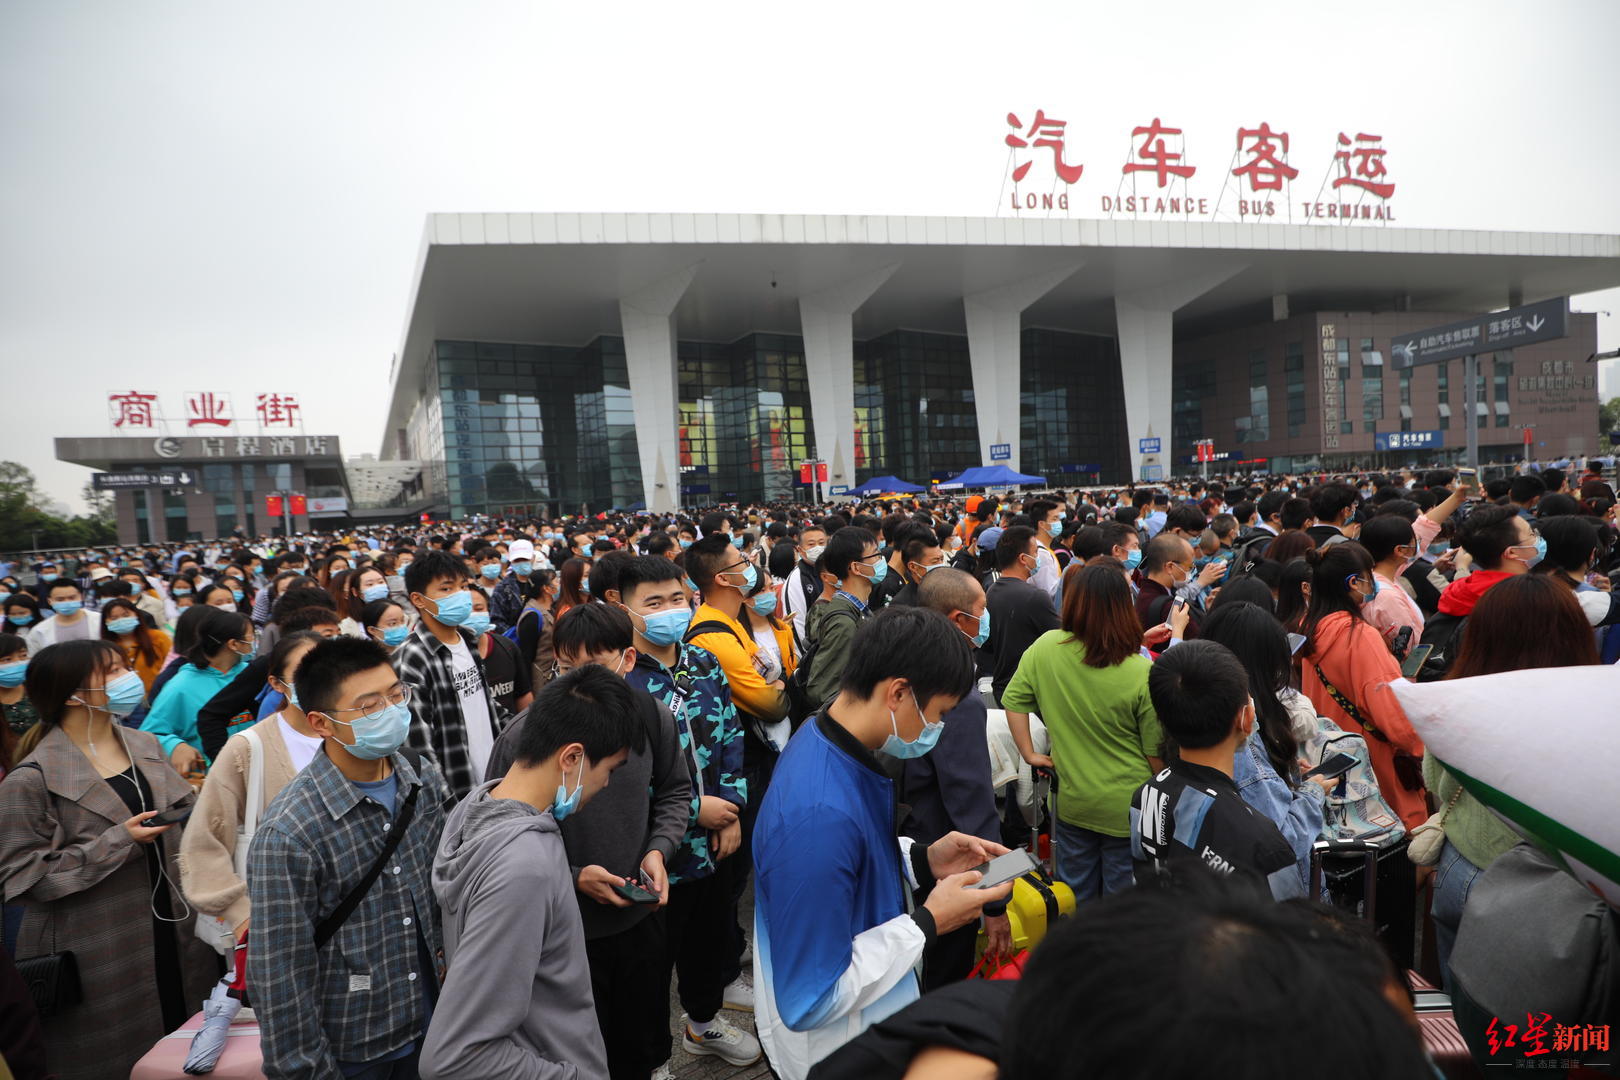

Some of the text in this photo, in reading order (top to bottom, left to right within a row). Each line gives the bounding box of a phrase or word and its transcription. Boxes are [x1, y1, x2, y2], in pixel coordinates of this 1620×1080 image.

[1005, 109, 1396, 200] 汽车客运
[1010, 193, 1396, 222] LONG DISTANCE BUS TERMINAL
[1489, 315, 1523, 334] 落客区
[109, 391, 300, 428] 商业街
[201, 436, 328, 457] 启程酒店
[1159, 795, 1170, 846] CALIFORNIA
